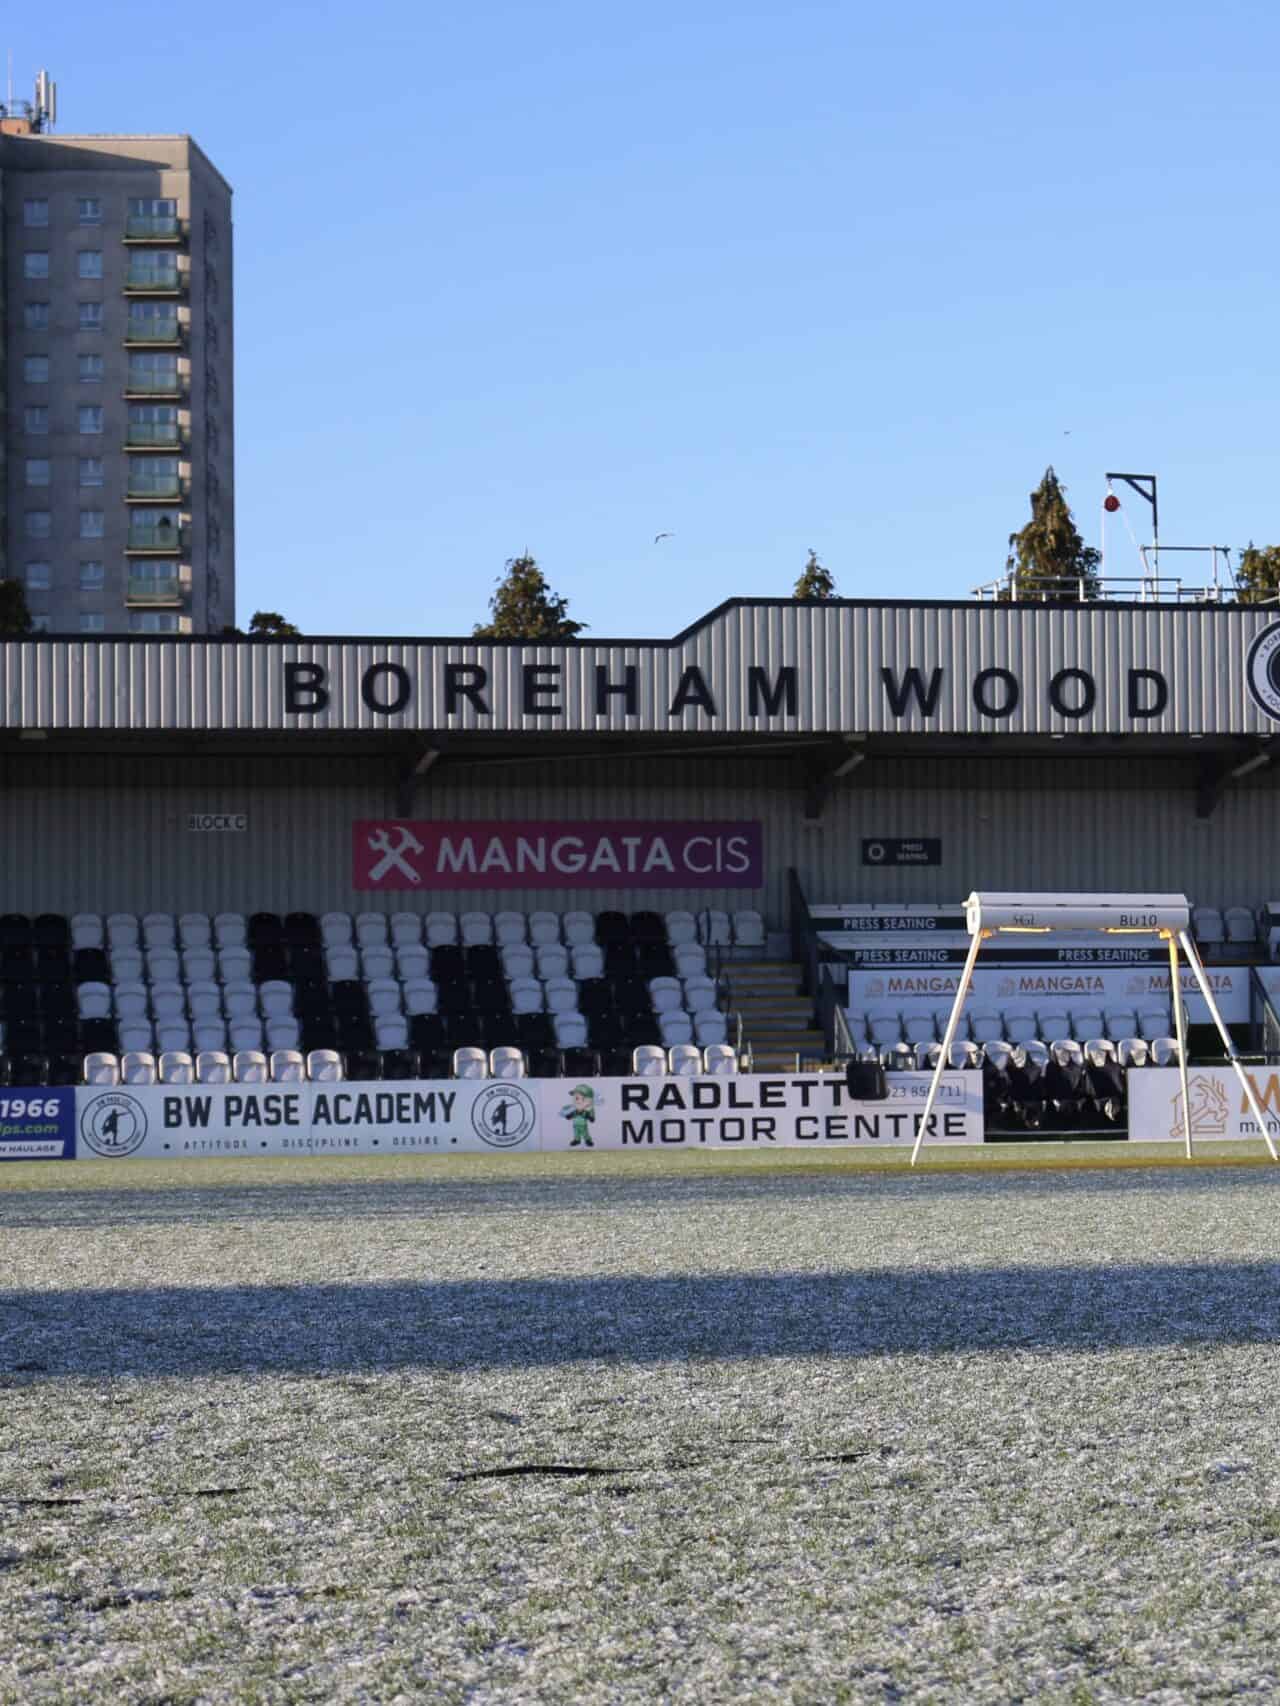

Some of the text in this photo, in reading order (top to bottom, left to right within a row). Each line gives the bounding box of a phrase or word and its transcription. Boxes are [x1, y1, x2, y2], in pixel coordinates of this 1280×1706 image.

[283, 662, 799, 717] BOREHAM
[880, 667, 1168, 718] WOOD
[436, 837, 750, 874] MANGATA CIS
[843, 918, 936, 930] PRESS SEATING
[855, 950, 948, 962] PRESS SEATING
[1058, 949, 1149, 961] PRESS SEATING
[888, 977, 975, 992] MANGAA
[1019, 976, 1105, 991] MANGATA
[621, 1079, 850, 1111] RADLETT
[1, 1099, 60, 1118] 1966
[163, 1091, 456, 1129] BW PASE ACADEMY
[621, 1112, 967, 1144] MOTOR CENTRE
